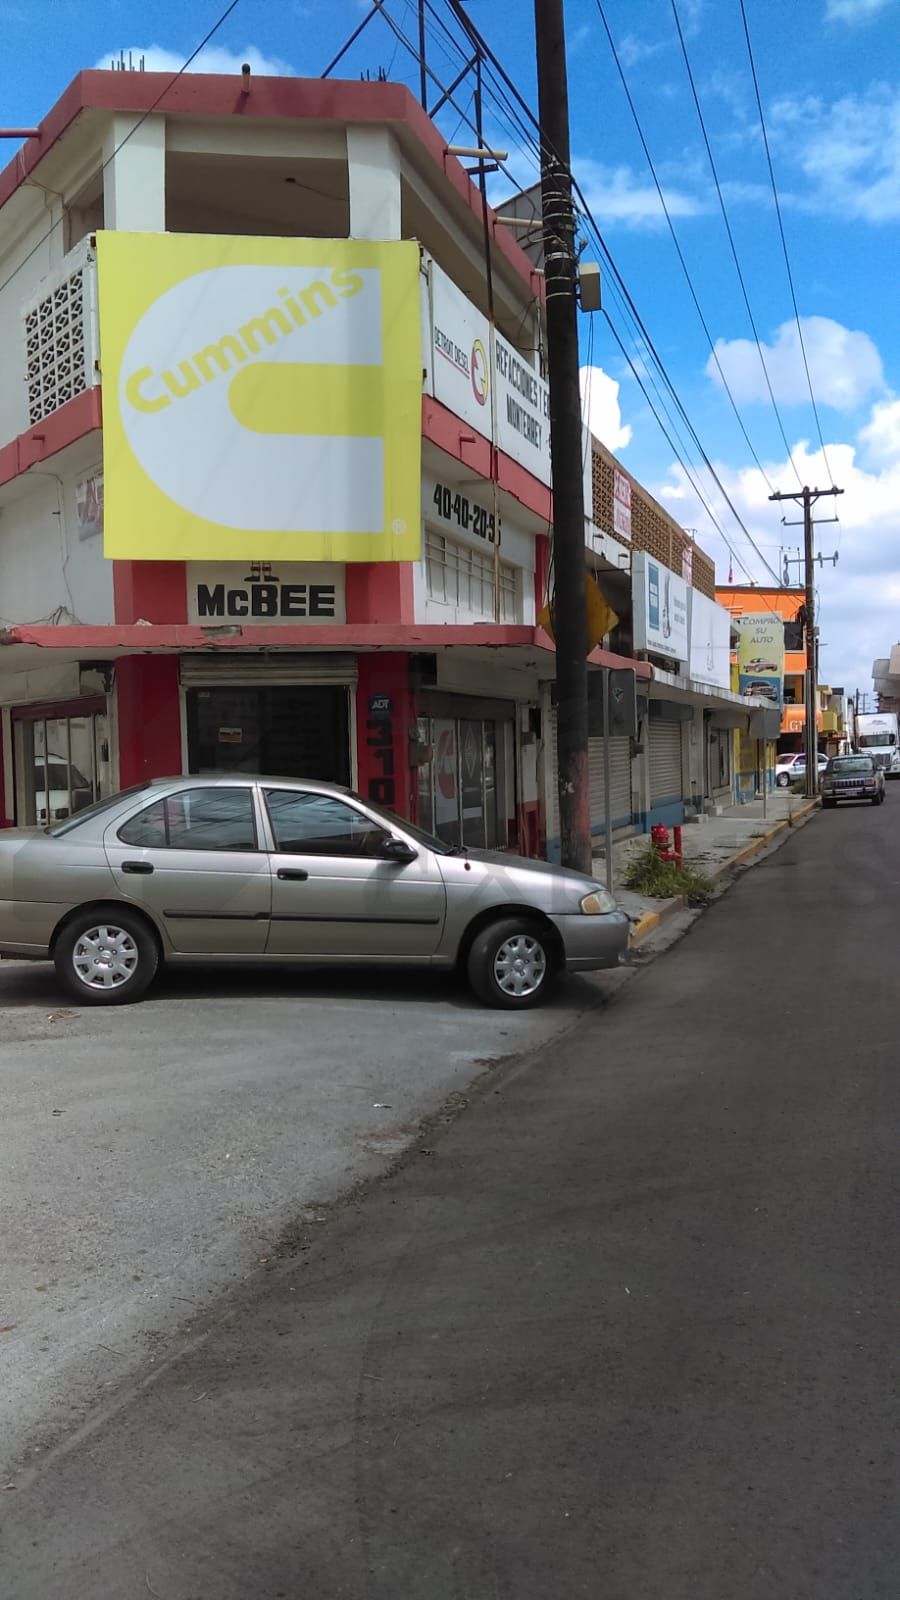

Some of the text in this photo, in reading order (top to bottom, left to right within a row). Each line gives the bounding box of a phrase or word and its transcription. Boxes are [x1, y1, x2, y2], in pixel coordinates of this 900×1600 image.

[126, 266, 364, 414] Cummins
[434, 326, 470, 374] DETROIT DIESEL
[495, 338, 538, 408] REFACCIONES
[506, 393, 542, 450] MONTERREY
[196, 584, 336, 617] McBEE
[743, 616, 781, 626] COMPRO
[750, 636, 774, 645] AUTO
[755, 627, 768, 635] SU
[371, 699, 390, 710] ADT
[366, 719, 394, 812] 310
